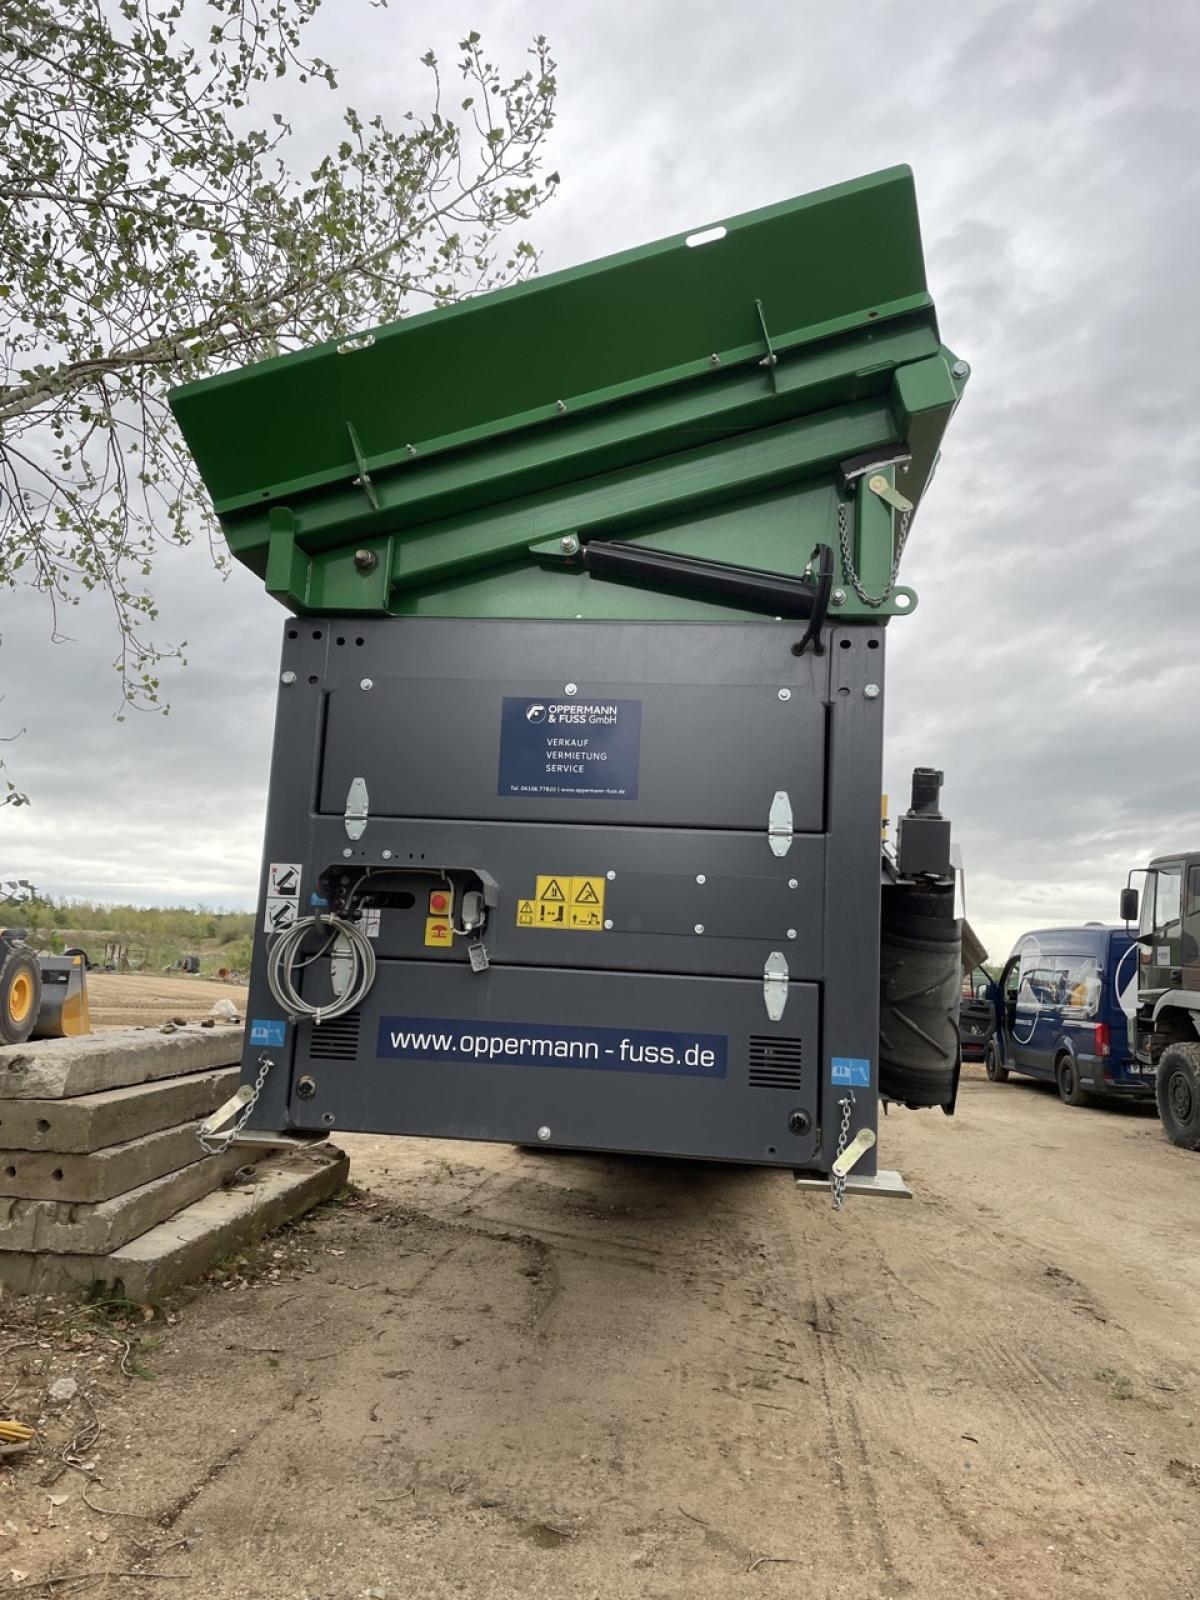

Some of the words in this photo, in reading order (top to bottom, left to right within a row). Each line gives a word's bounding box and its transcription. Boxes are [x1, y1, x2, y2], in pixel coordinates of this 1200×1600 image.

[548, 704, 617, 715] OPPERMANN
[548, 714, 556, 724] &
[559, 714, 586, 724] FUSS
[588, 715, 617, 725] GmbH
[546, 738, 589, 747] VERKAUF
[545, 751, 607, 761] VERMIETUNG
[545, 764, 584, 773] SERVICE
